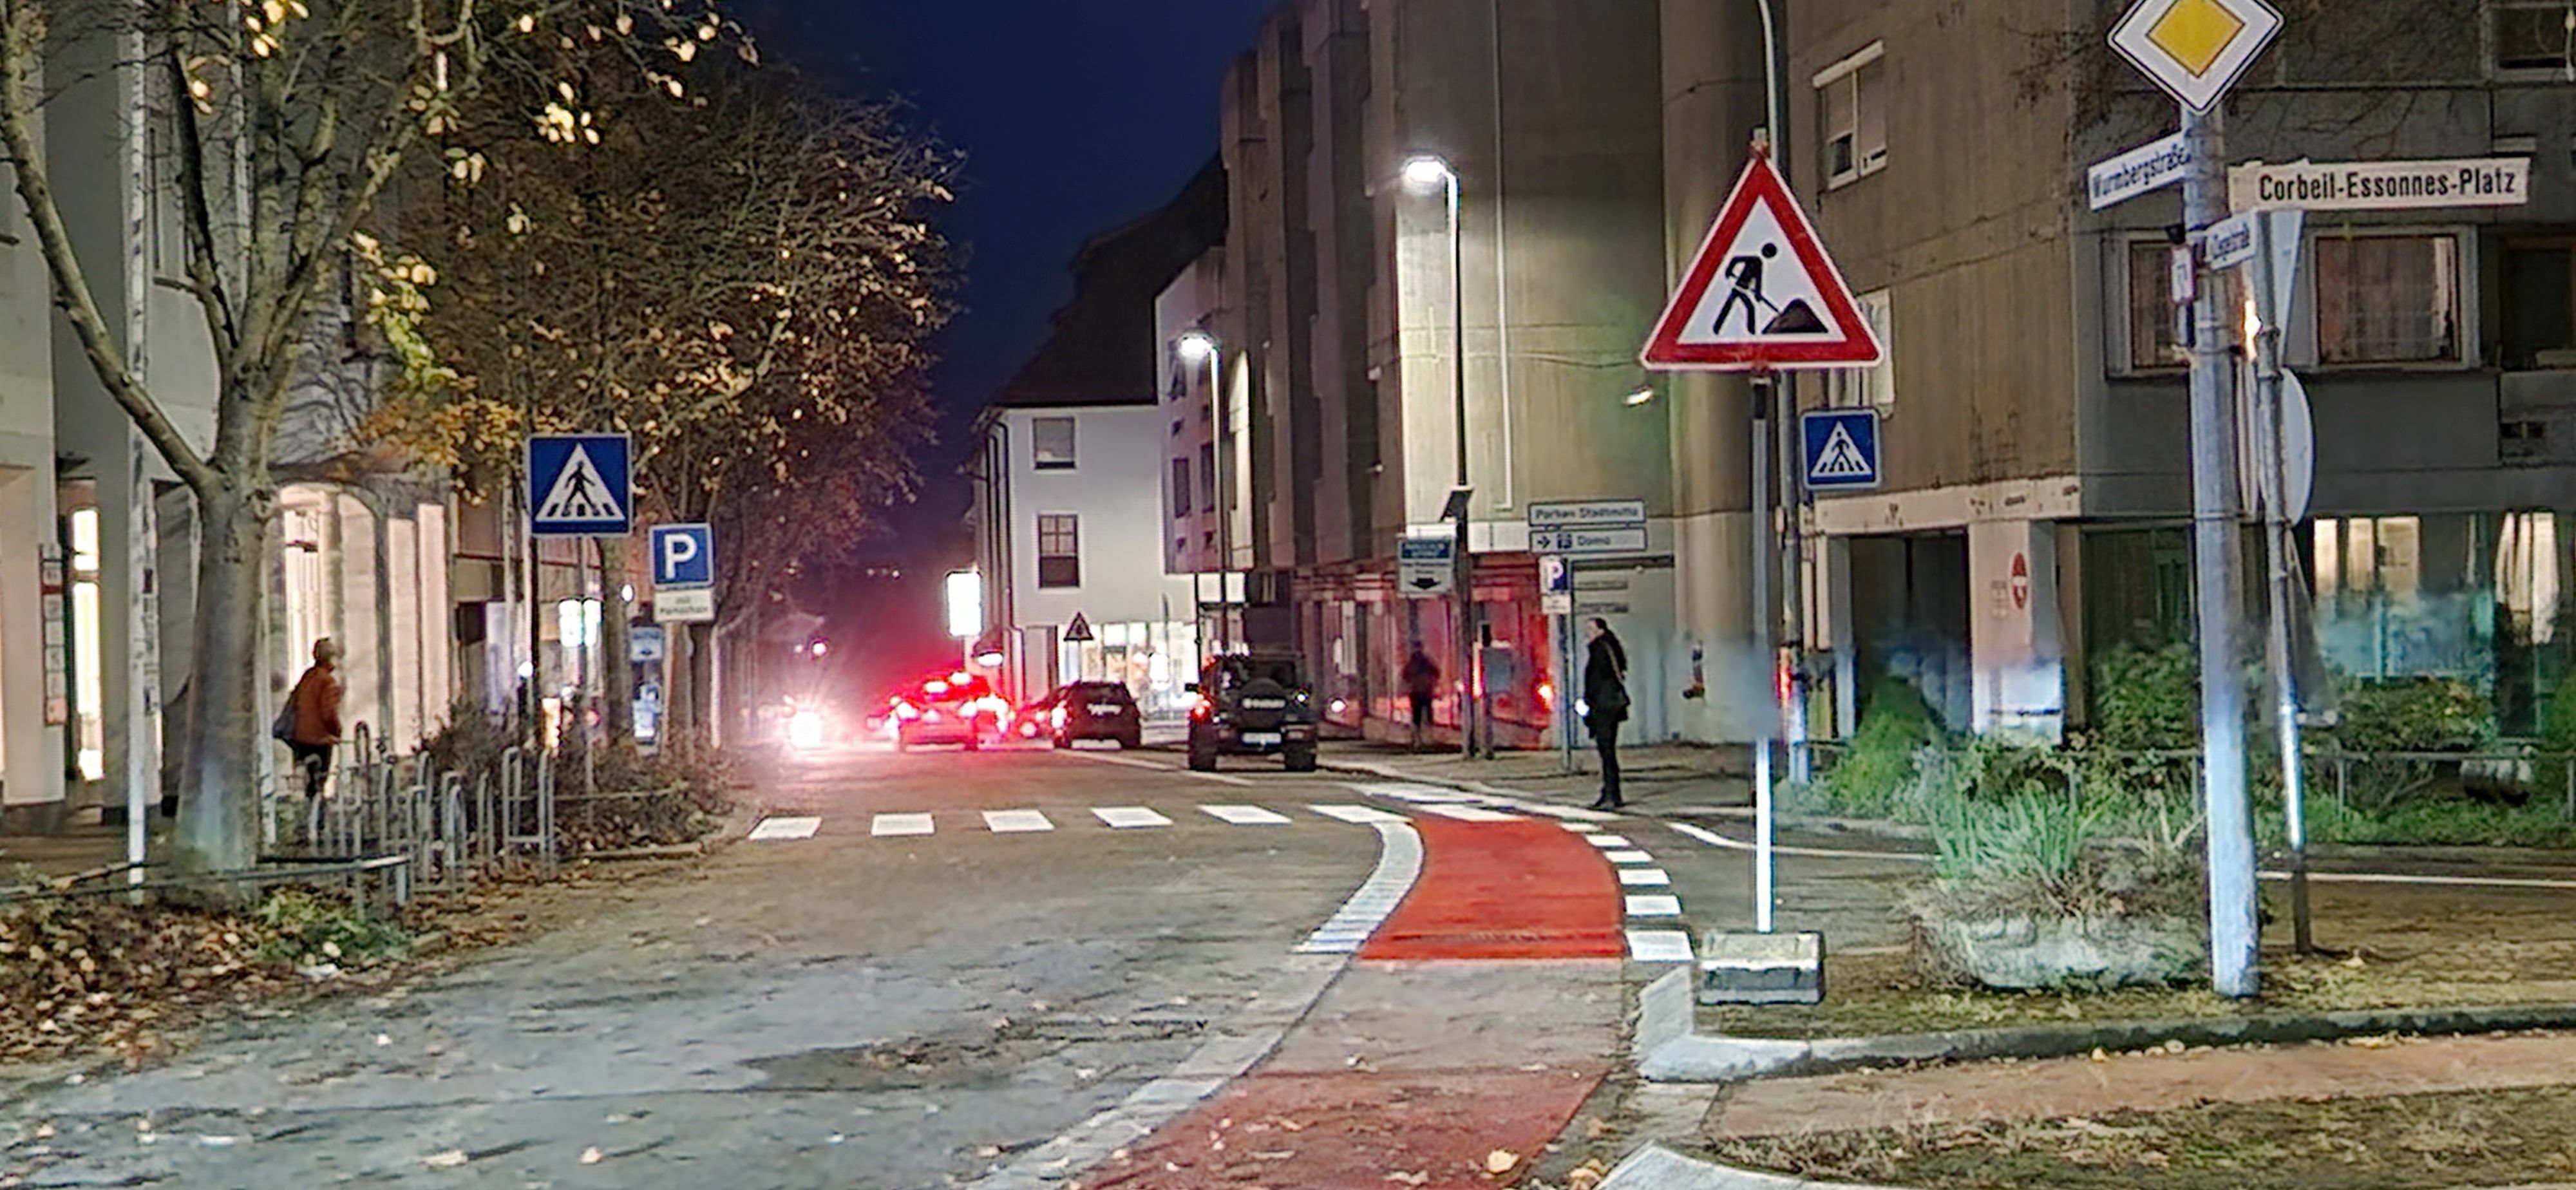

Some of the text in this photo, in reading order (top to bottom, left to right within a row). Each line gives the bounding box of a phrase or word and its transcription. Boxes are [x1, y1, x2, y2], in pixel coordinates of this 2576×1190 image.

[2259, 168, 2516, 201] Corbeil-Essonnes-Platz
[664, 533, 697, 579] P
[1546, 559, 1564, 590] P
